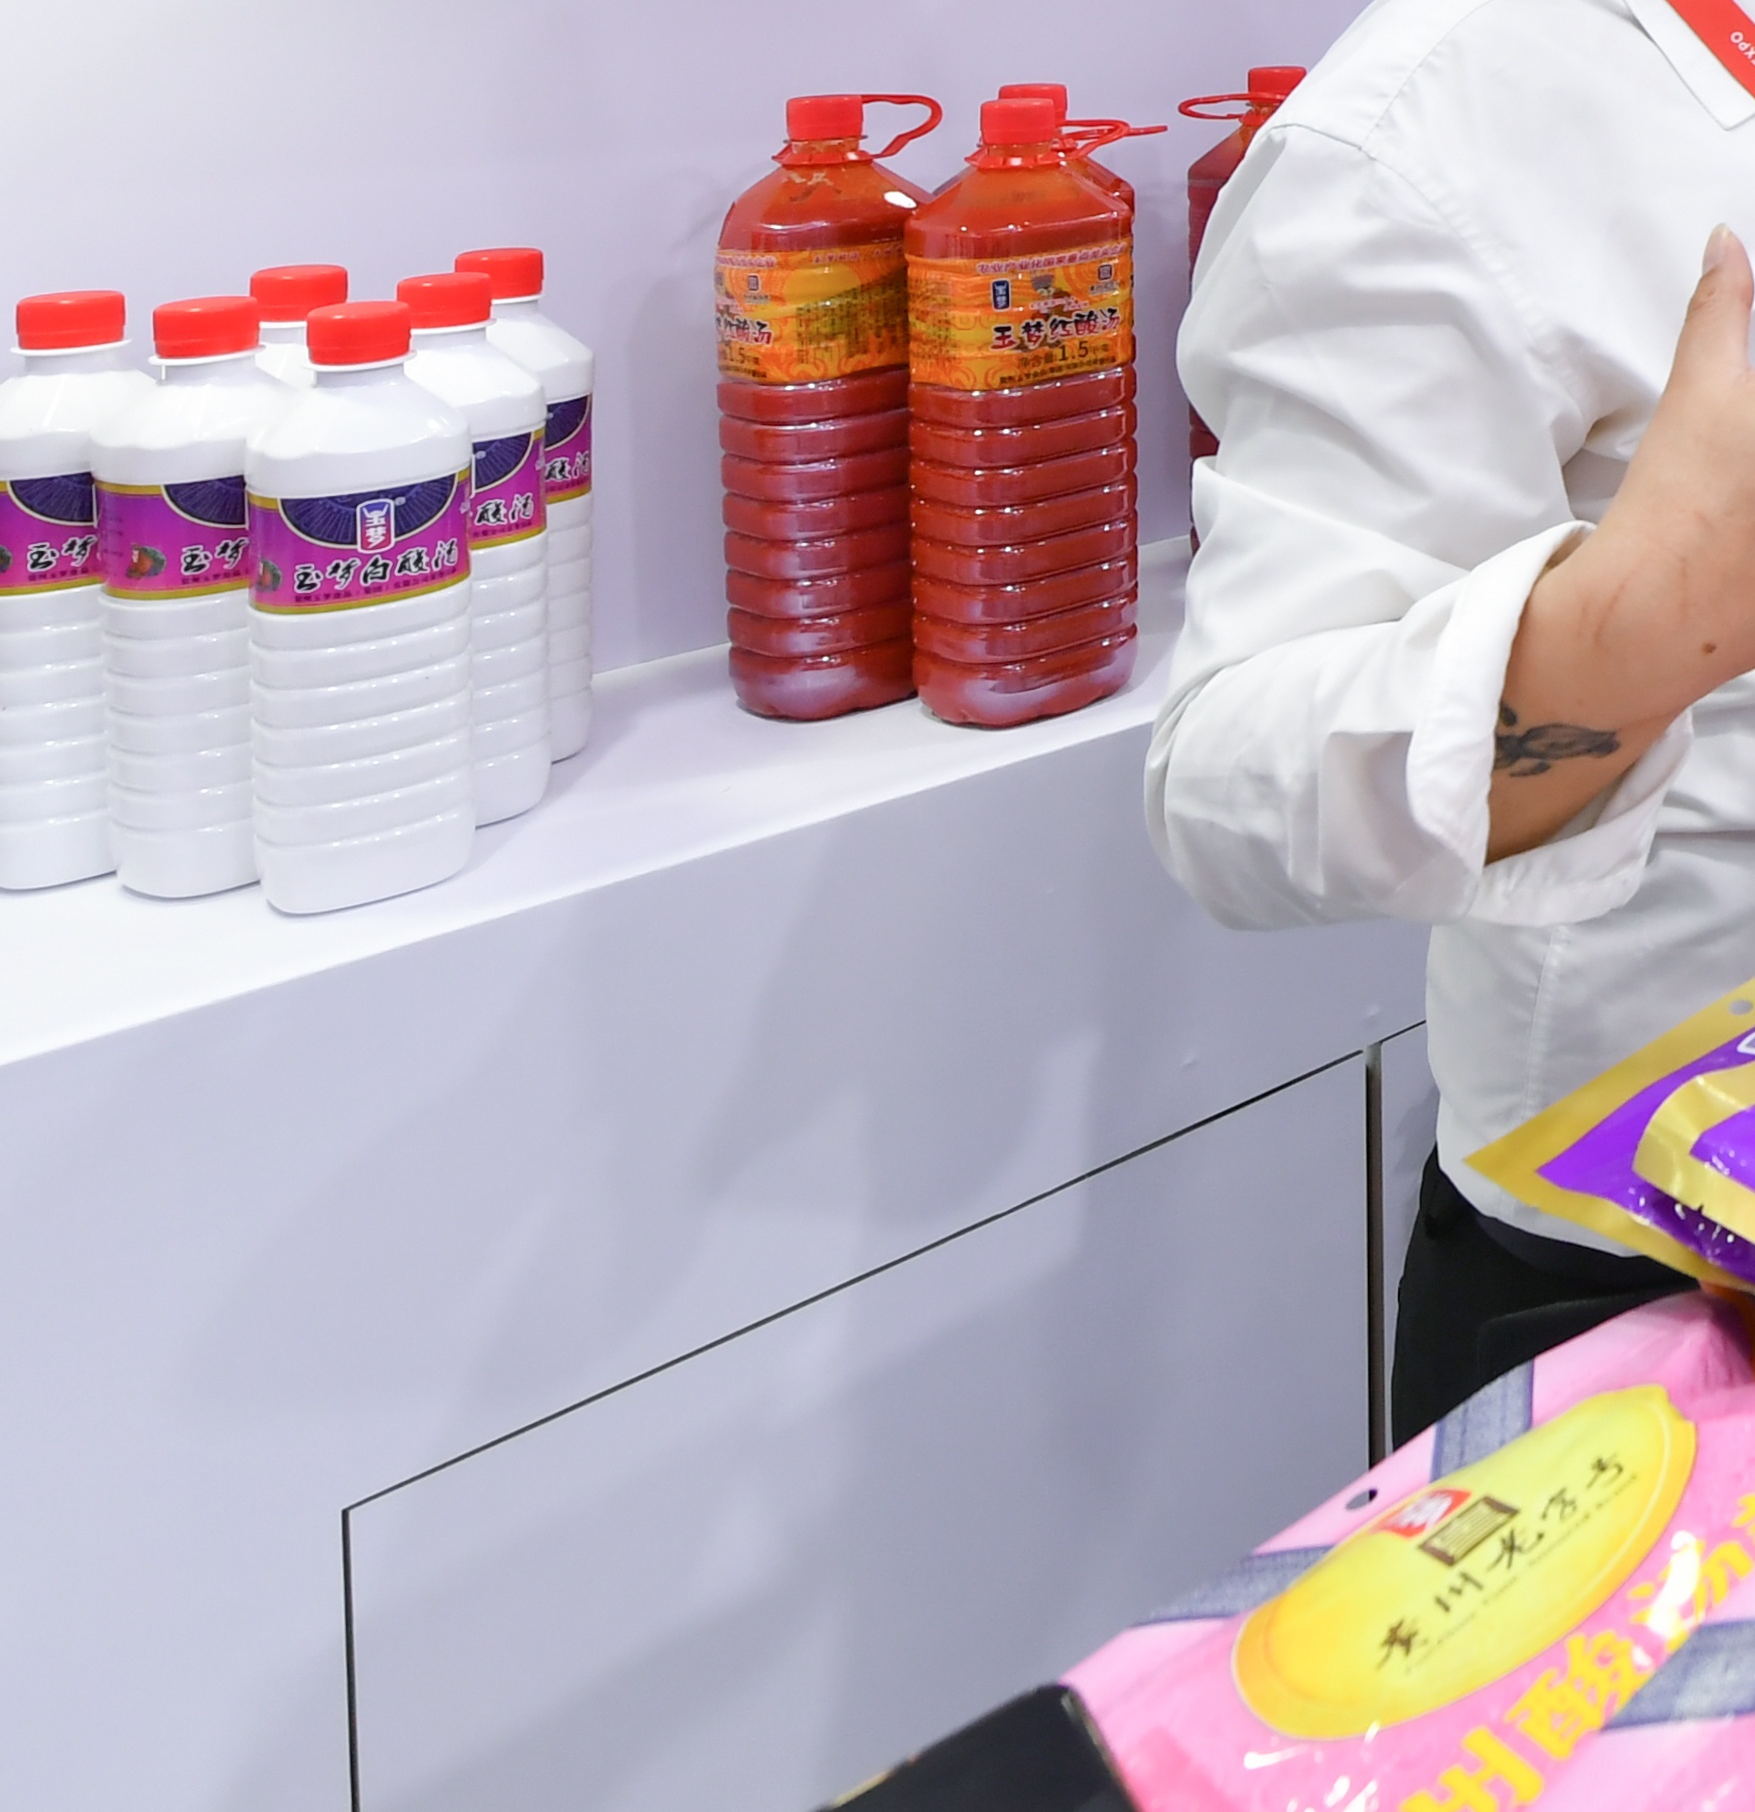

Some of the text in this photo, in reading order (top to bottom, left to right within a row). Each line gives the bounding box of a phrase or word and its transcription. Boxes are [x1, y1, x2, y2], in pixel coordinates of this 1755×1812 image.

[990, 308, 1121, 351] 玉梦红酸汤
[360, 504, 392, 551] 玉梦
